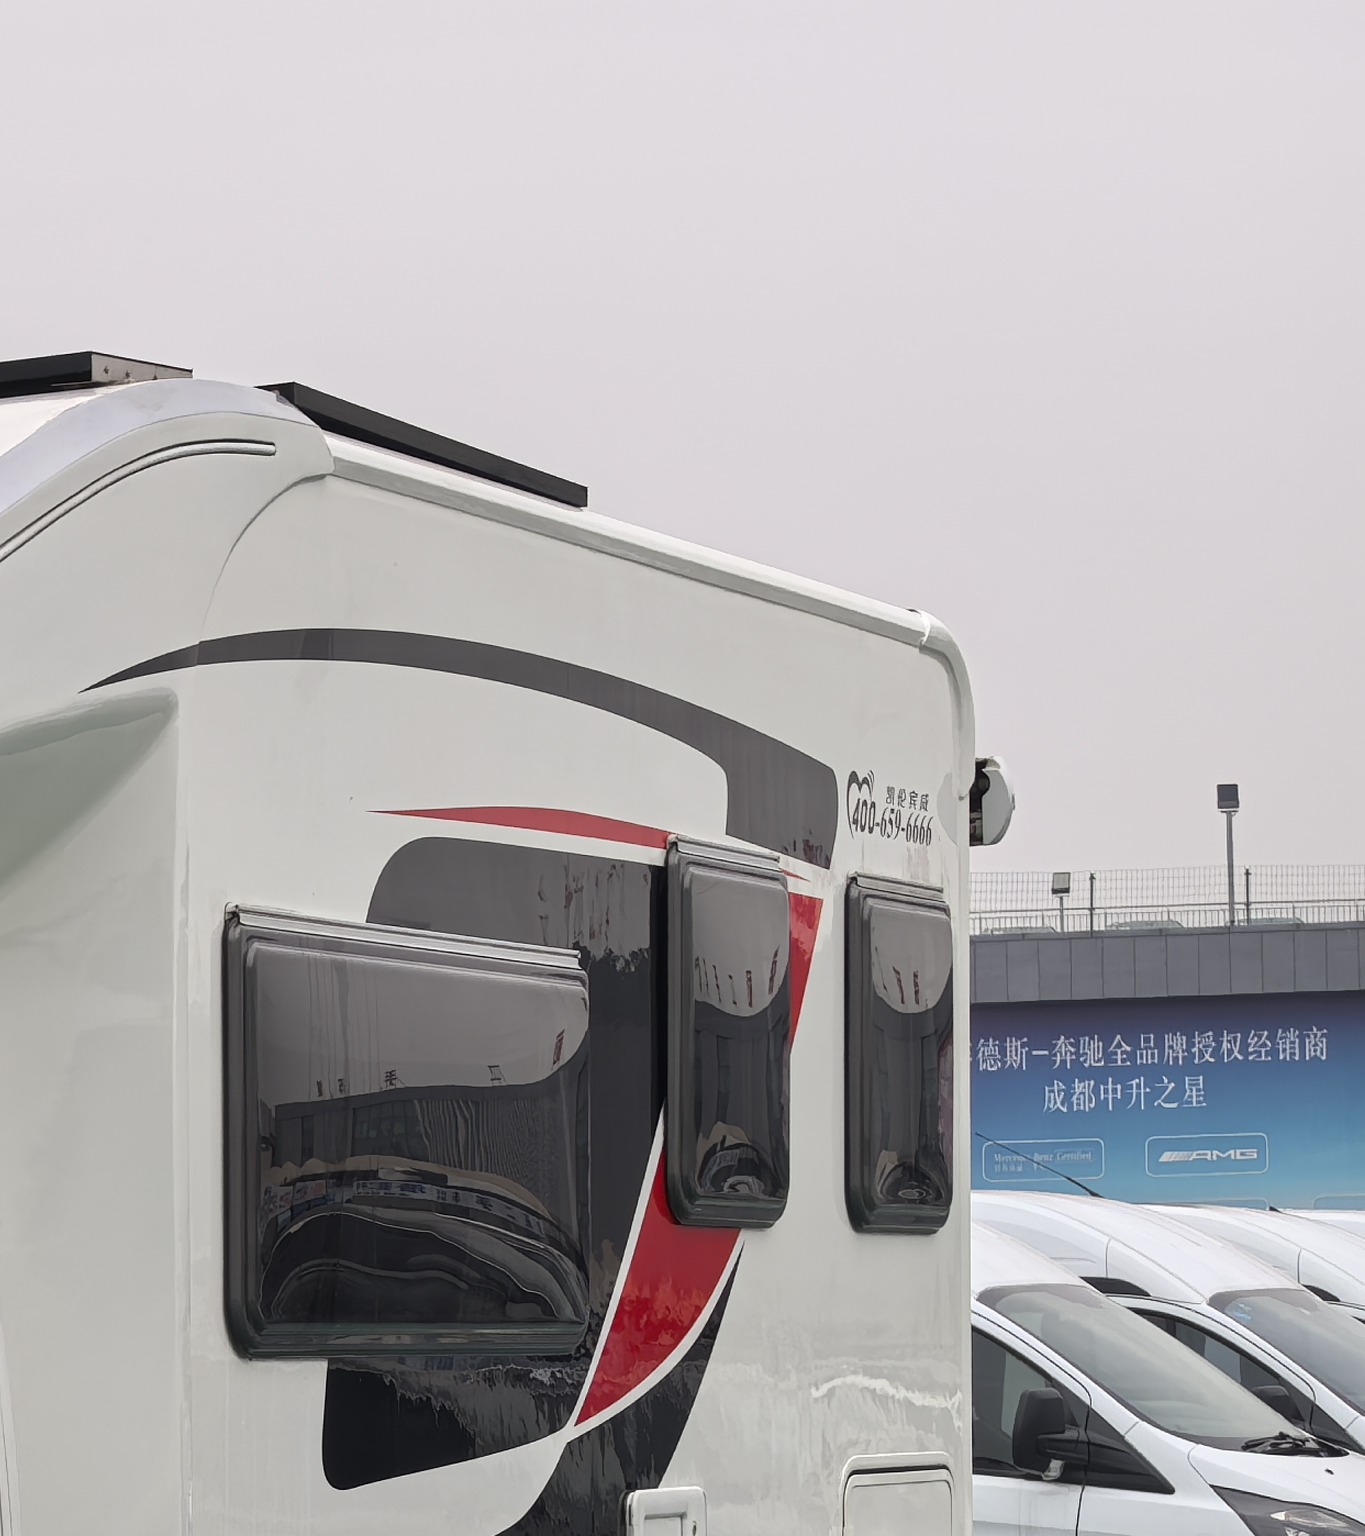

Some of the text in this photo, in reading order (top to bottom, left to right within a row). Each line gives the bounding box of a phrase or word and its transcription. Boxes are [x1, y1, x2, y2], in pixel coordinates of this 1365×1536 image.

[852, 798, 934, 847] 400-659-6666
[969, 1025, 1329, 1073] 德斯-奔驰全品牌授权经销商
[1042, 1075, 1207, 1115] 成都中升之星
[1188, 1148, 1258, 1161] AMG
